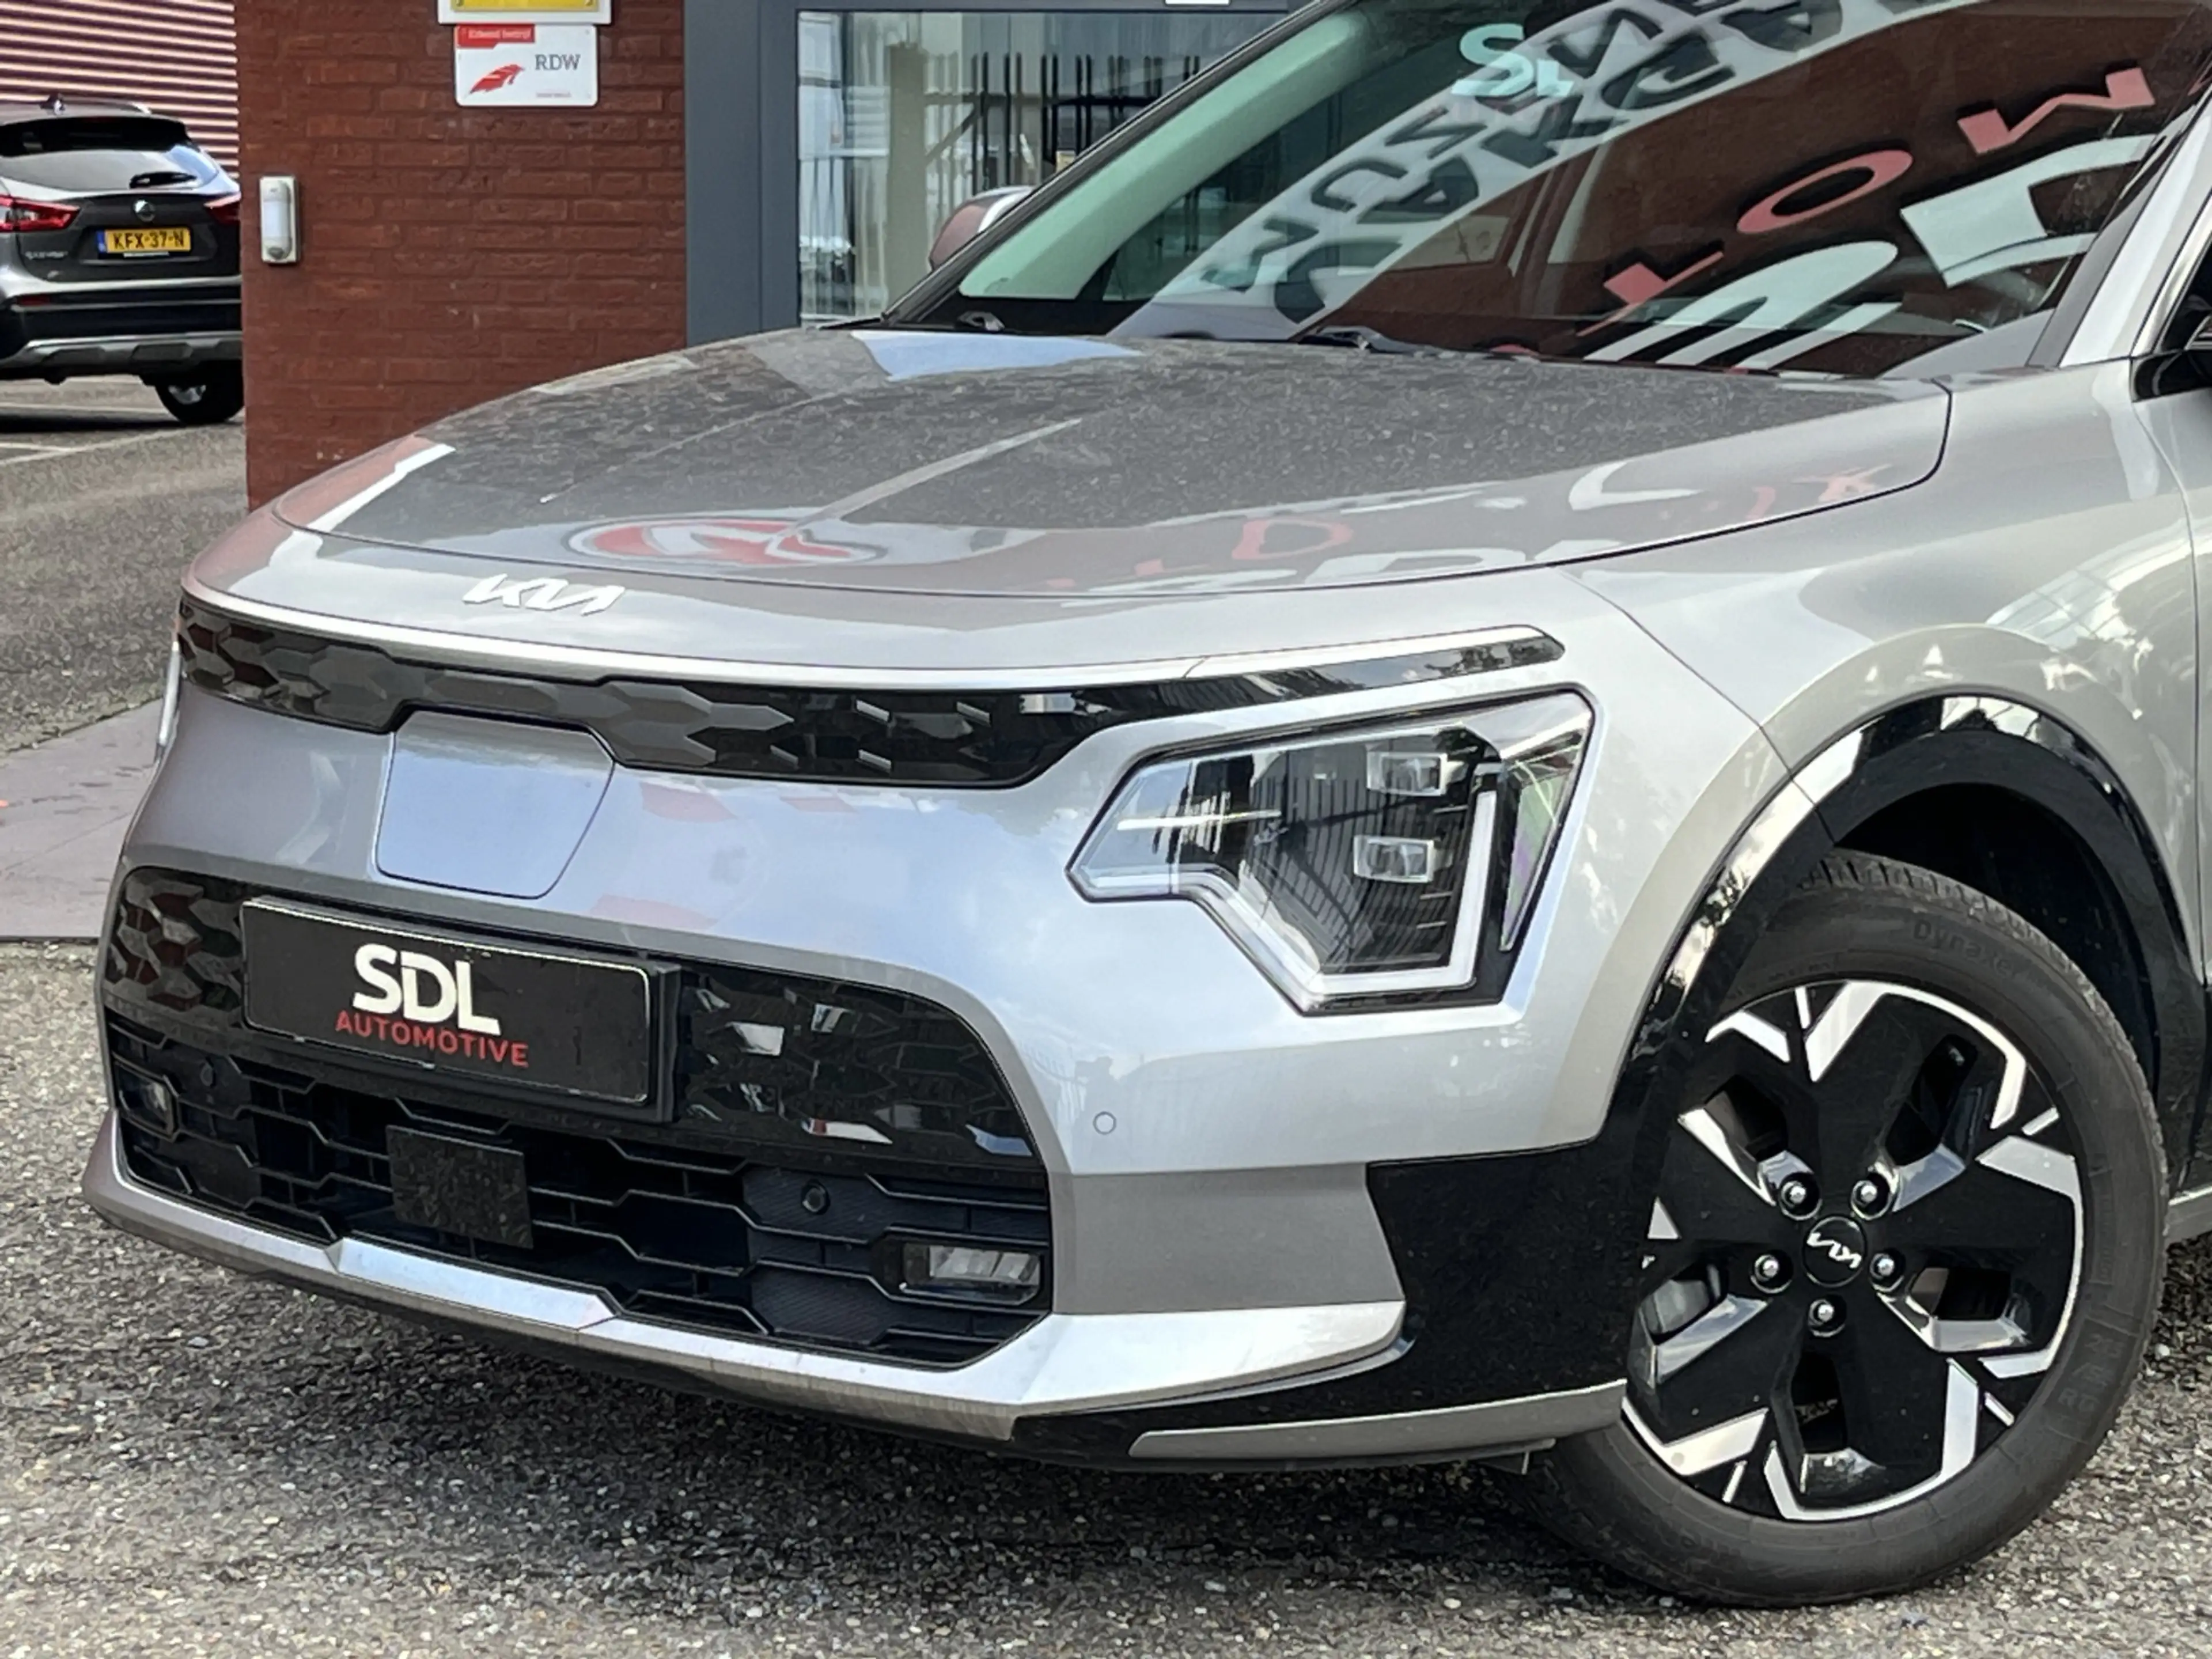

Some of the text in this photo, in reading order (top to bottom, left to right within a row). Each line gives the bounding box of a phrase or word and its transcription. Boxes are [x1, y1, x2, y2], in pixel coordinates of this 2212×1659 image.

[534, 54, 581, 71] RDW
[112, 230, 184, 249] KFX-37-N
[352, 943, 501, 1035] SDL
[335, 1011, 529, 1068] AUTOMOTIVE
